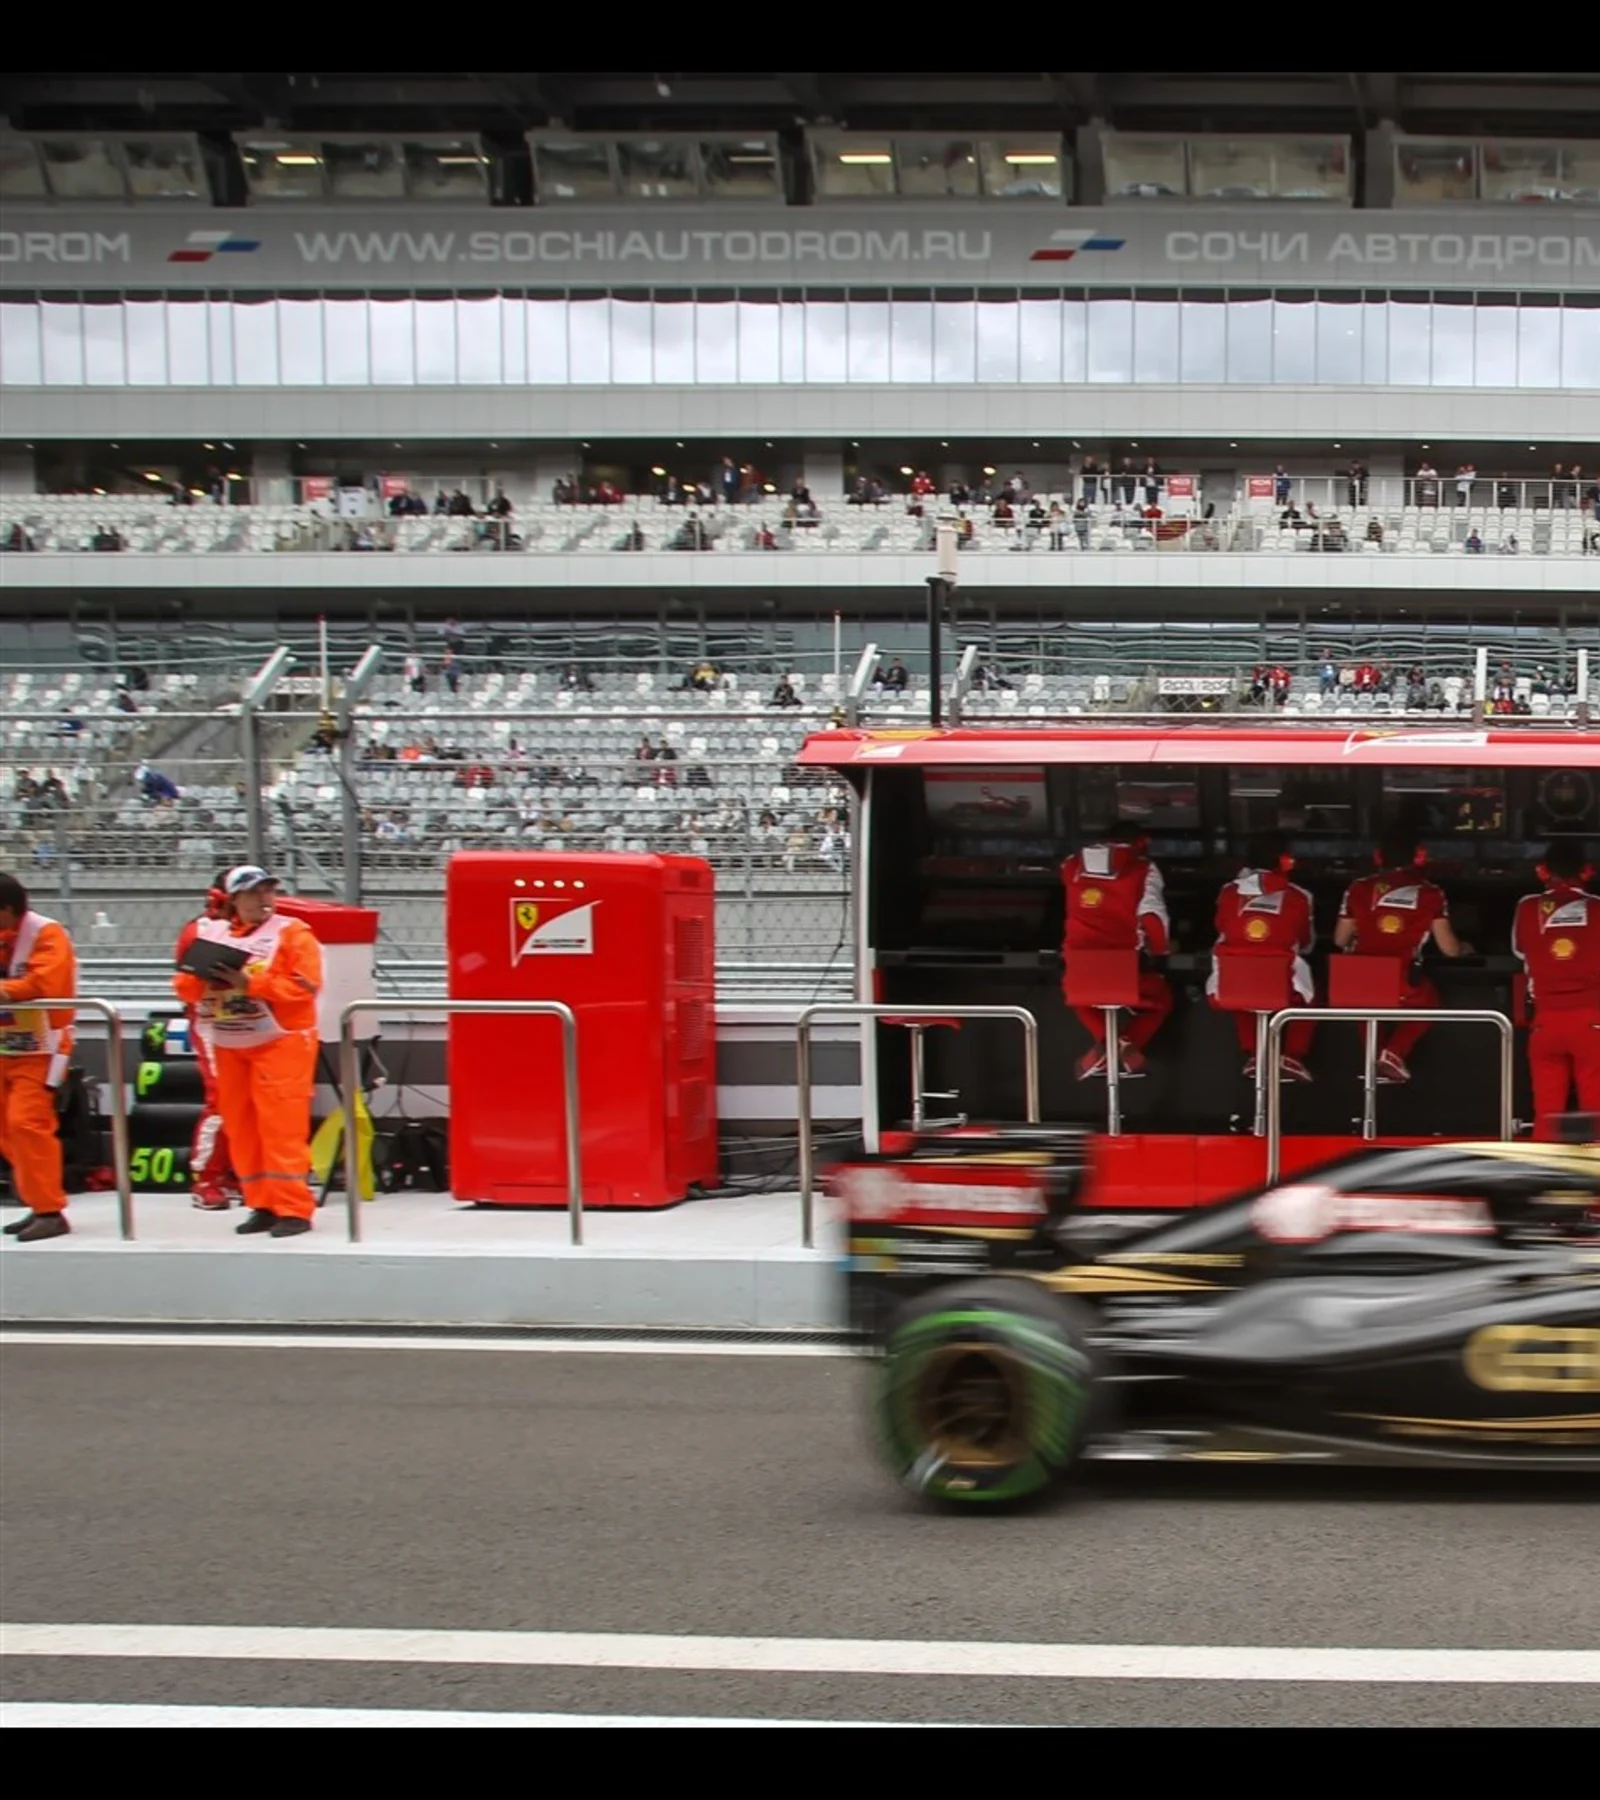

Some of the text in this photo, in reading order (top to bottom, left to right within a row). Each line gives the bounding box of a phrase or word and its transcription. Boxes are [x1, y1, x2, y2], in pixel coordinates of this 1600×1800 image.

[294, 231, 992, 264] WWW.SOCHIAUTODROM.RU
[1164, 231, 1308, 263] СОЧИ
[137, 1061, 163, 1096] P
[129, 1147, 186, 1184] 50.
